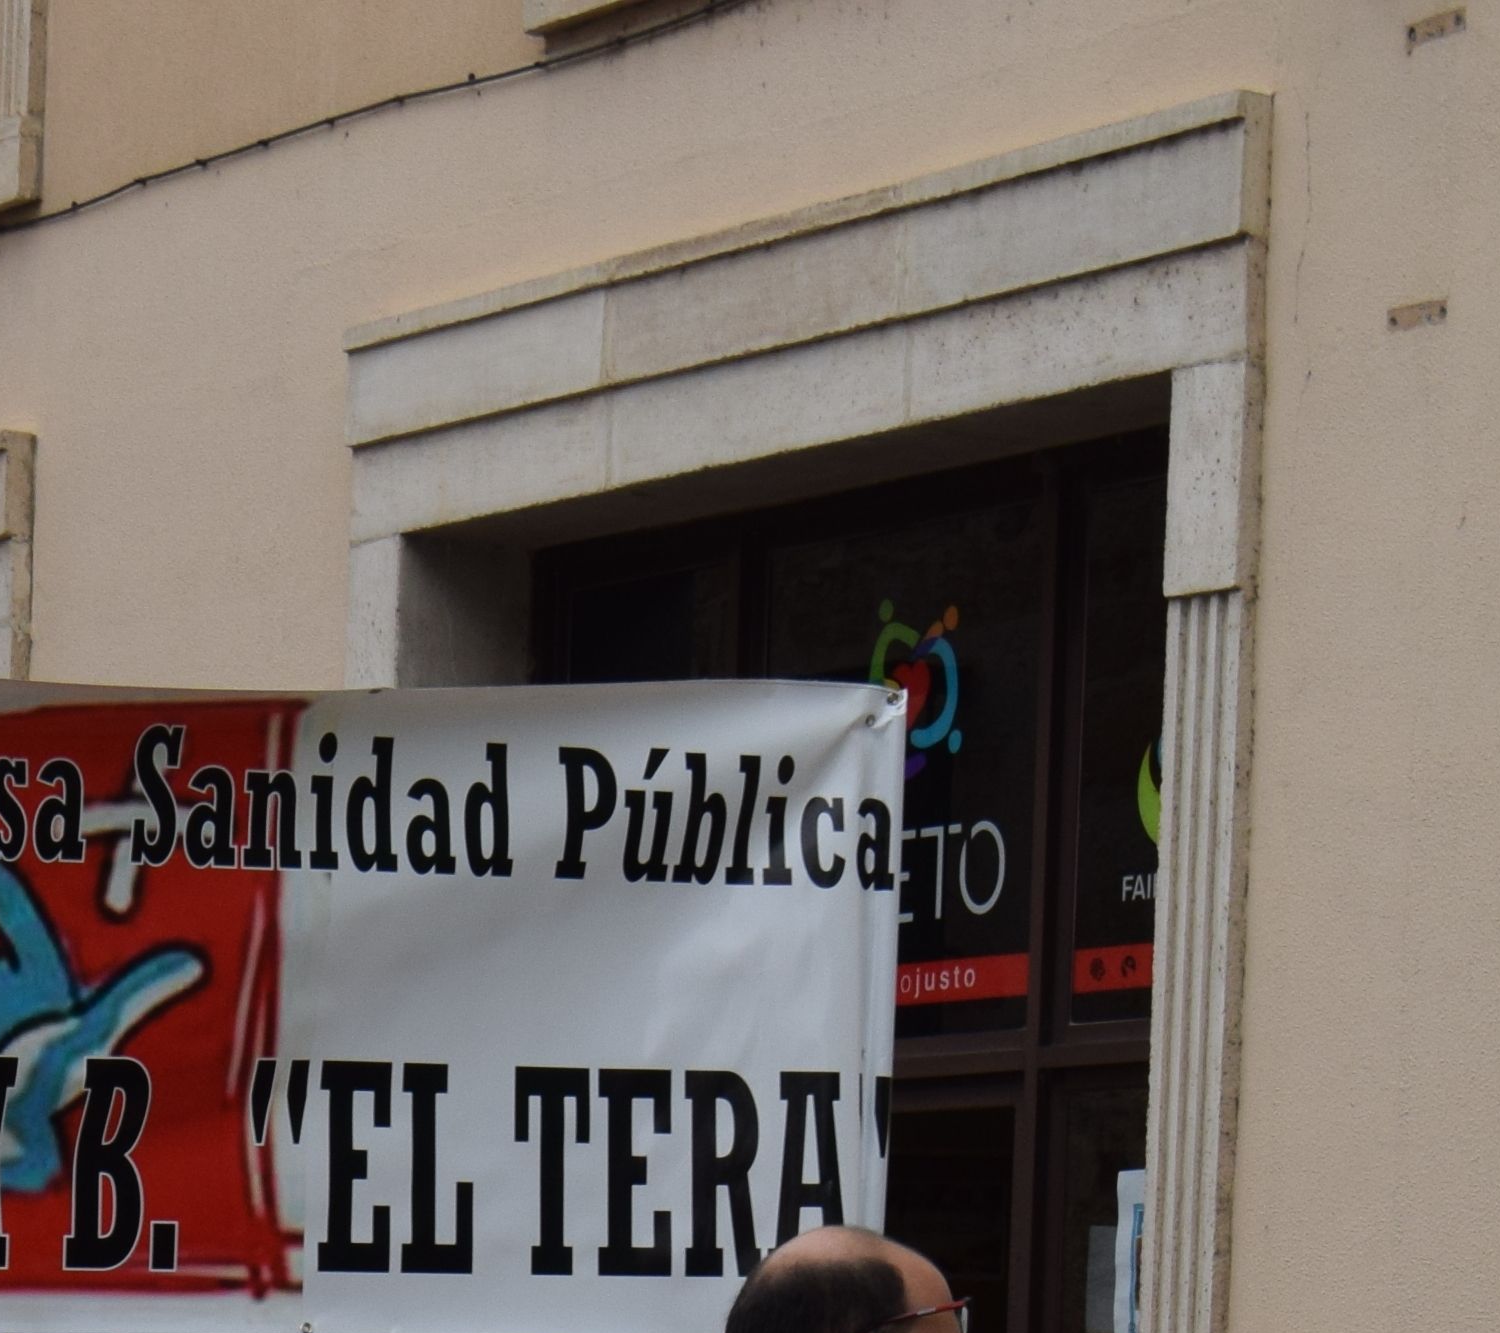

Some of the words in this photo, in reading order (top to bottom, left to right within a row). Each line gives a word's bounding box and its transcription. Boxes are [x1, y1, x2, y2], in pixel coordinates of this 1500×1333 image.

[129, 722, 513, 879] Sanidad
[555, 746, 895, 892] Pública
[63, 1055, 180, 1274] B.
[250, 1057, 474, 1277] "EL
